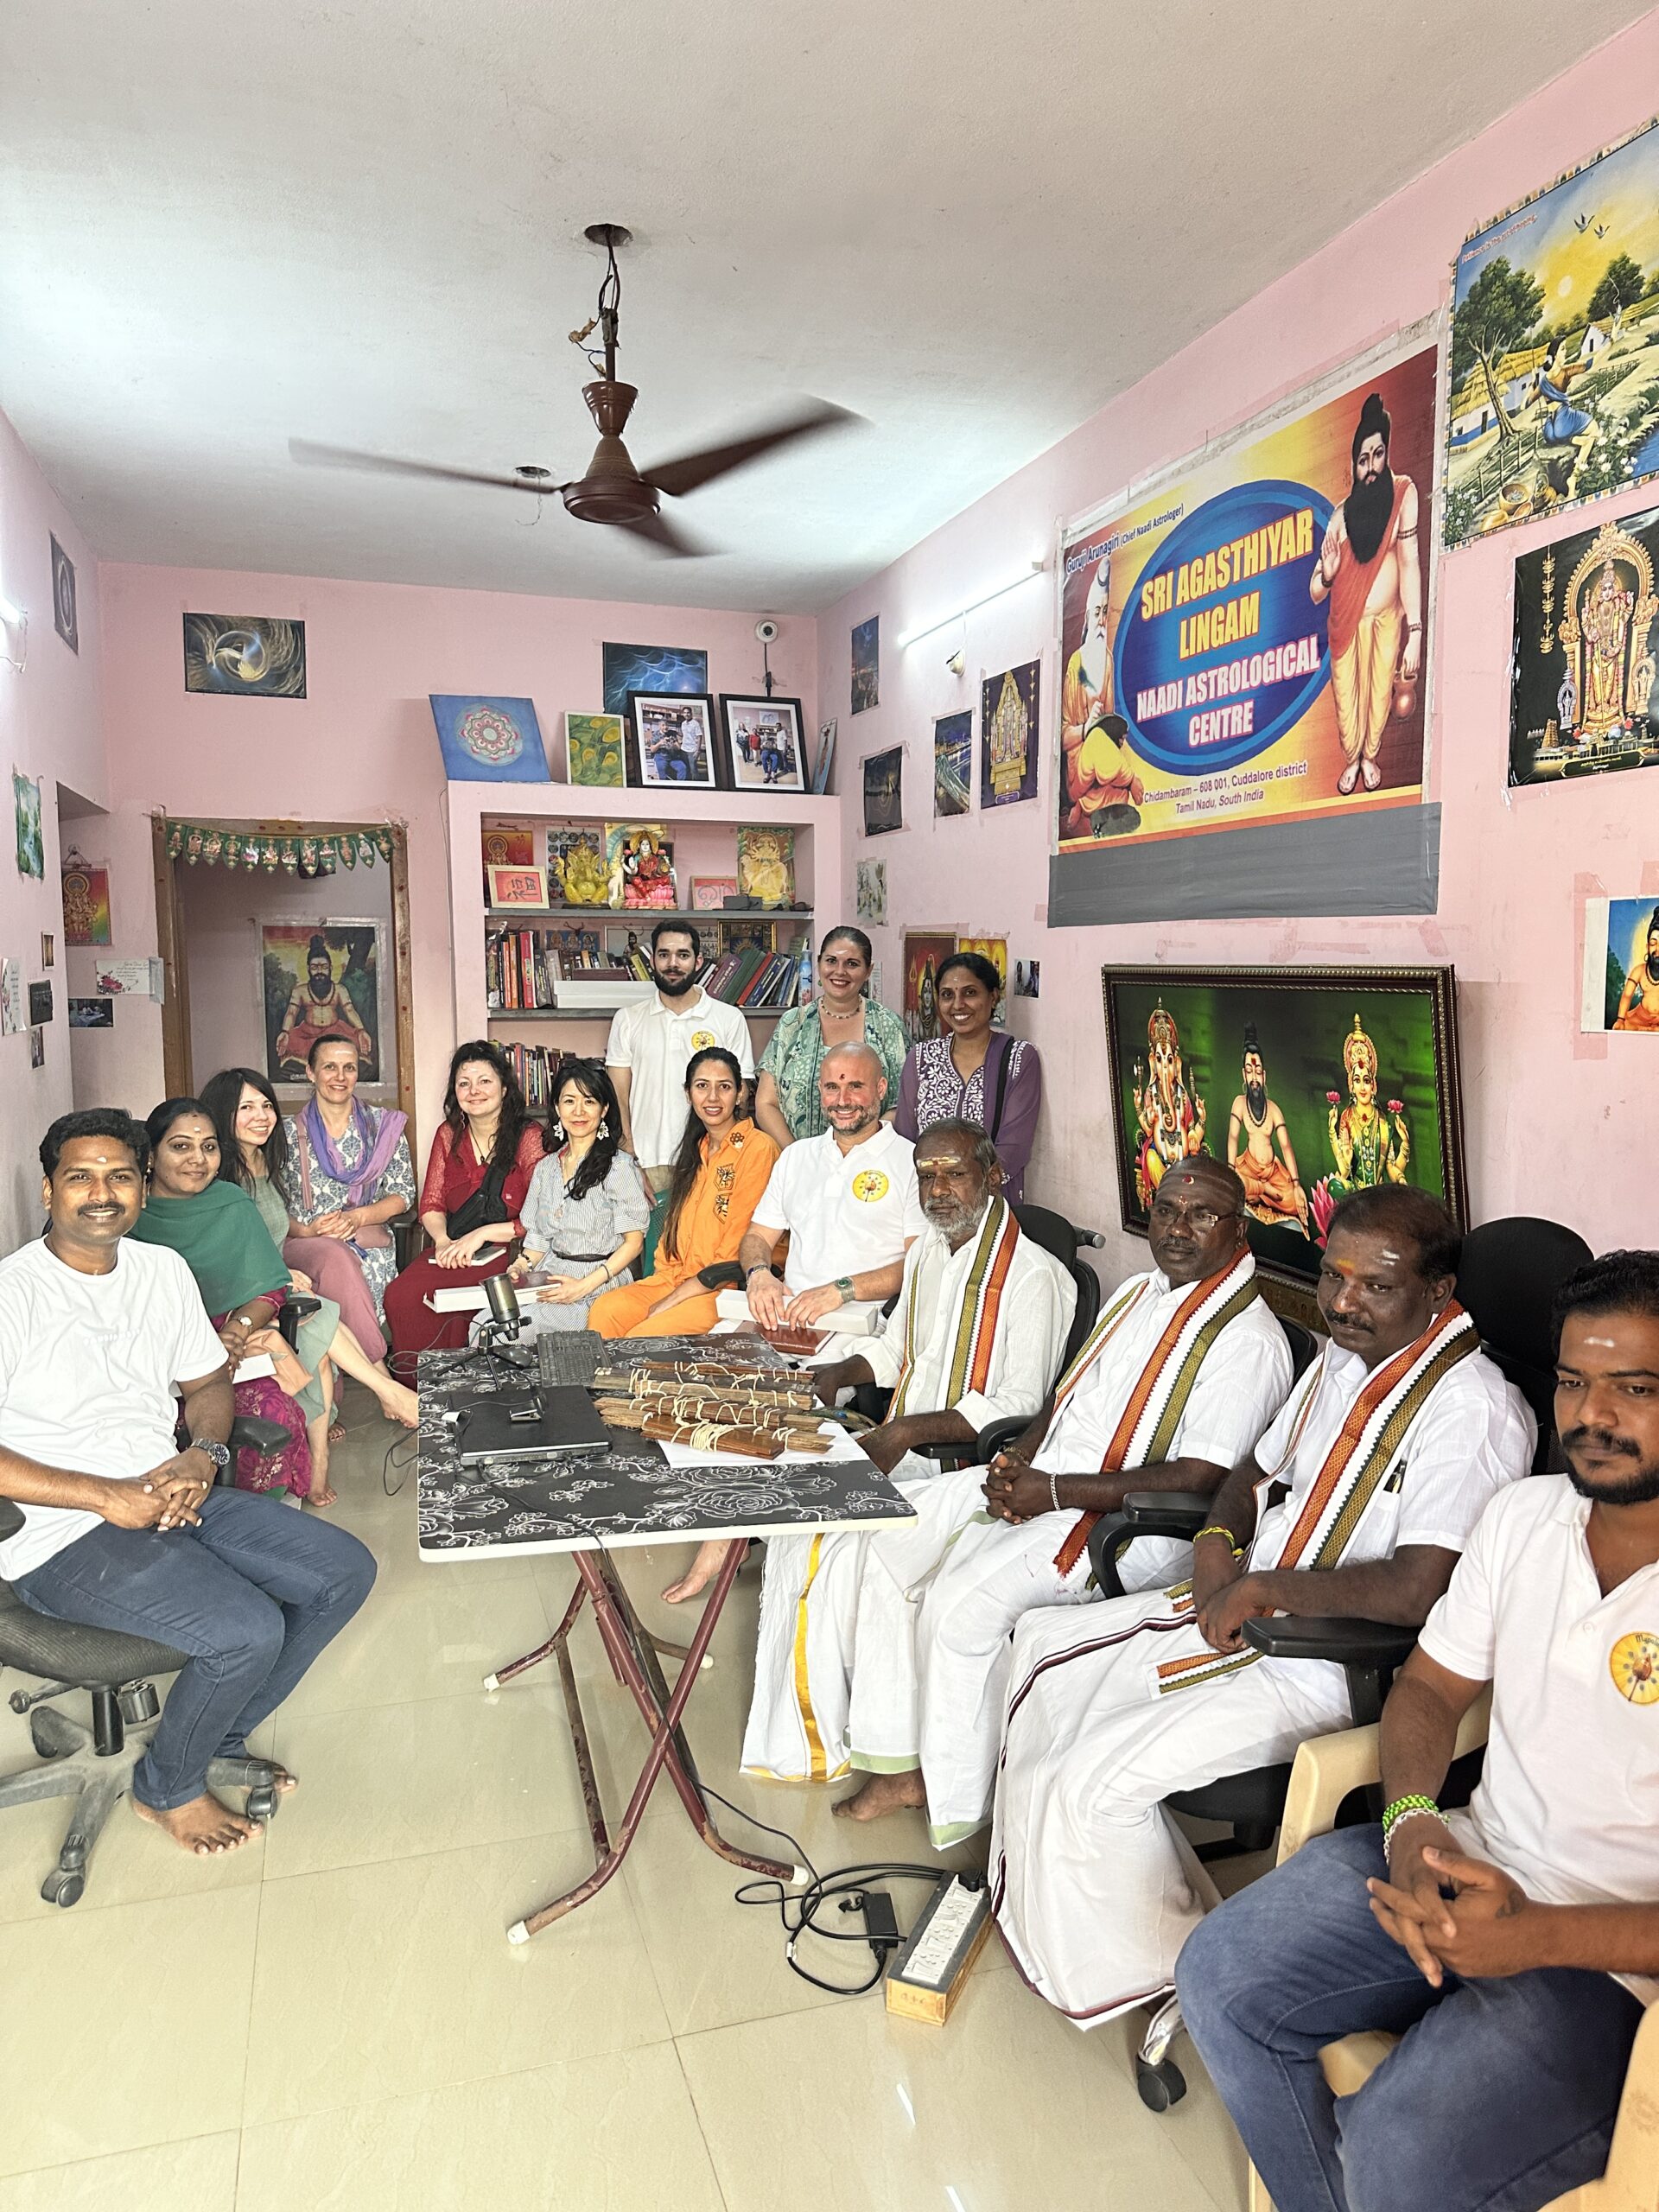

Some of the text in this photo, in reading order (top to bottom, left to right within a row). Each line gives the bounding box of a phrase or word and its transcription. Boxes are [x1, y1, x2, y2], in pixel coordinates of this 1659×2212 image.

[1066, 503, 1184, 574] Guruji Arunagiri (Chief Naadi Astrologer)
[1141, 507, 1313, 621] SRI AGASTHIYAR
[1179, 591, 1260, 660] LINGAM
[1136, 633, 1321, 723] NAADI ASTROLOGICAL
[1189, 699, 1254, 747] CENTRE
[1144, 785, 1192, 804] Chidambaram
[1199, 780, 1212, 792] 608
[1214, 778, 1230, 791] 001,
[1231, 770, 1274, 787] Cuddalore
[1275, 761, 1306, 779] district
[1176, 789, 1264, 814] Tamil Nadu, South India
